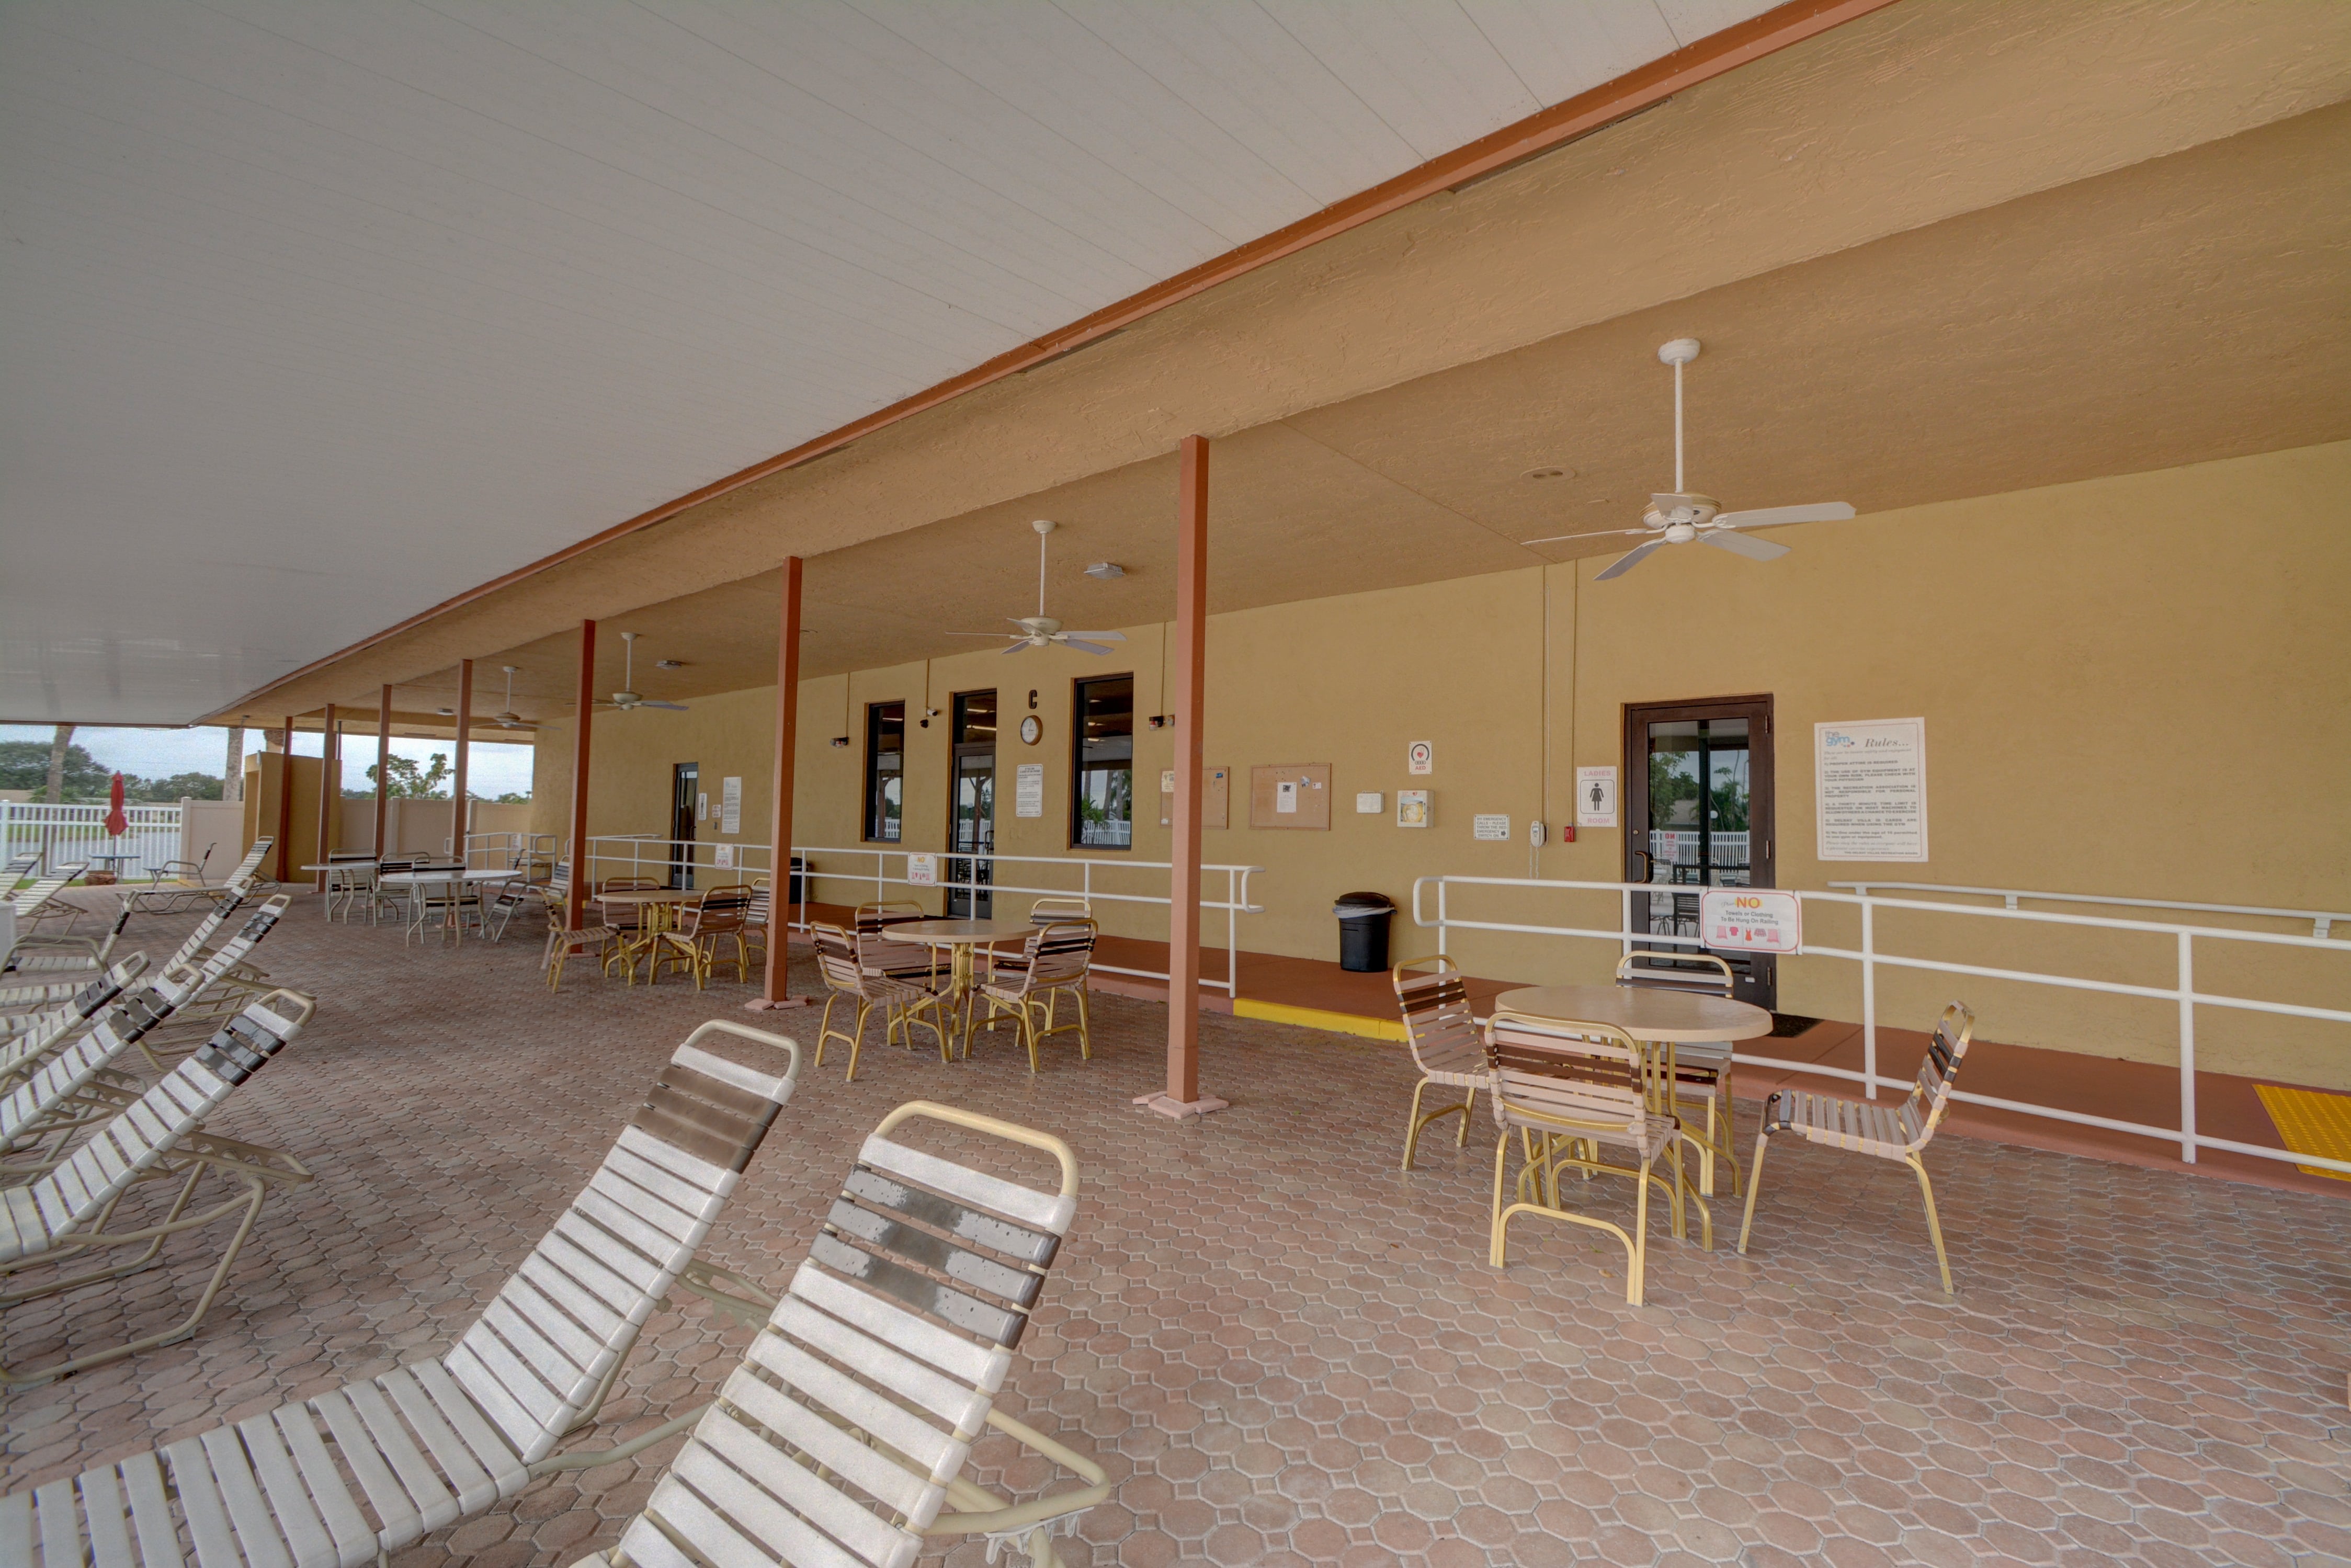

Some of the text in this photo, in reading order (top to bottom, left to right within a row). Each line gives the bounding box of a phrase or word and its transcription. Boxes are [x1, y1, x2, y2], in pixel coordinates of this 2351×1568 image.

[1826, 736, 1850, 746] gym
[1866, 738, 1909, 747] Rules...
[1736, 896, 1760, 908] NO
